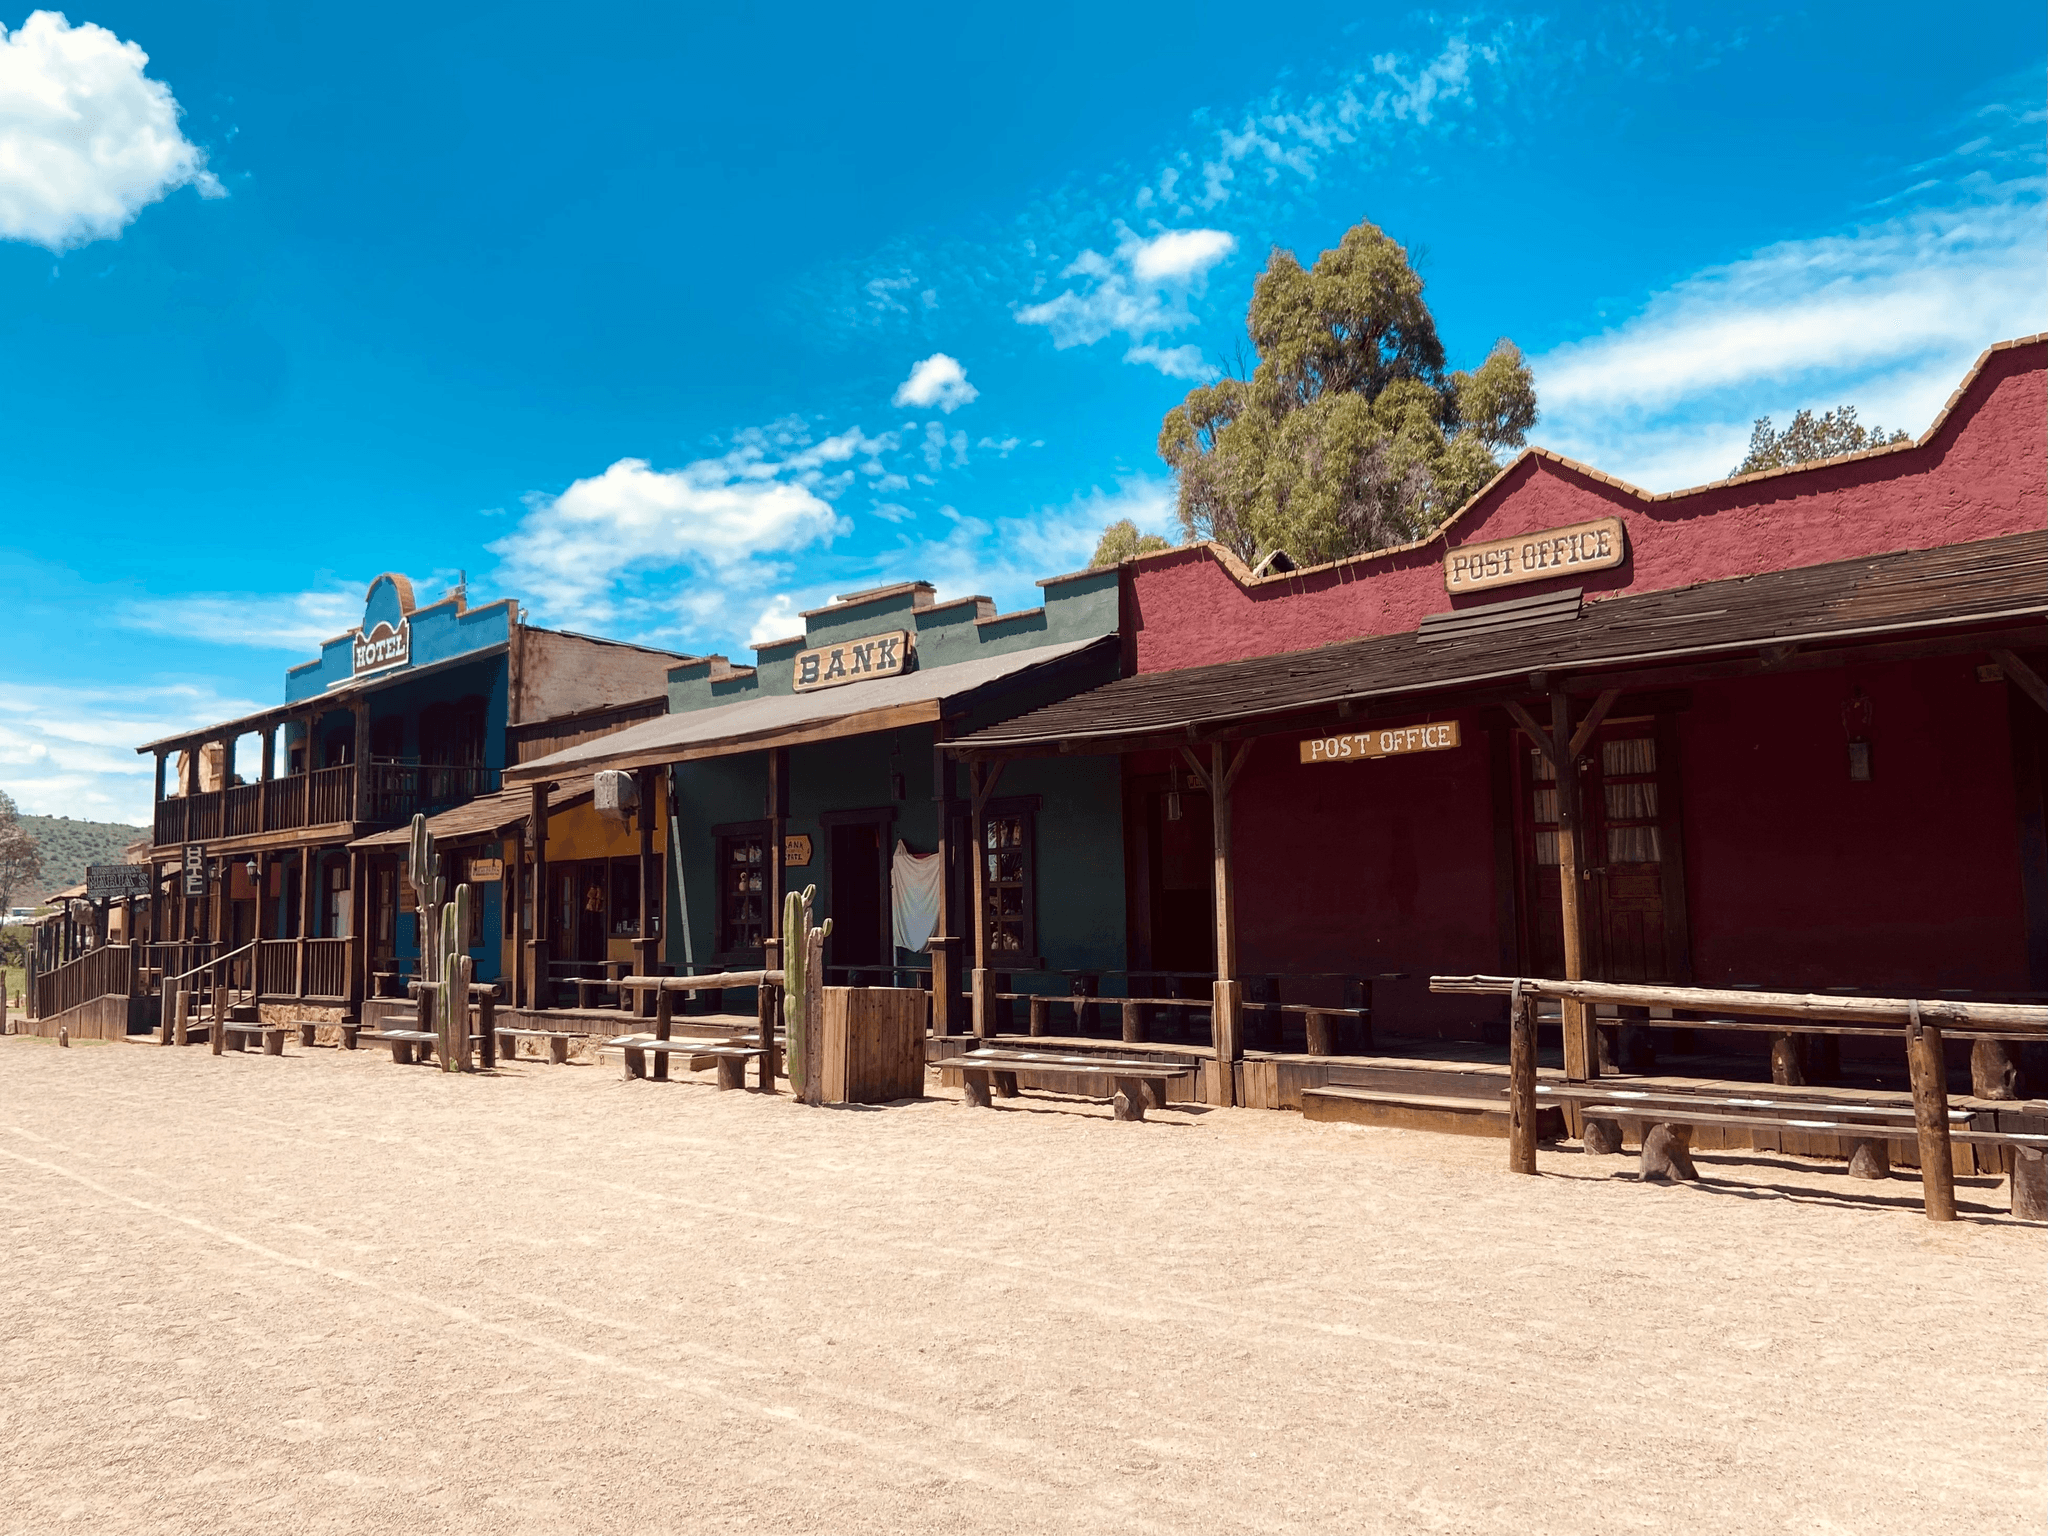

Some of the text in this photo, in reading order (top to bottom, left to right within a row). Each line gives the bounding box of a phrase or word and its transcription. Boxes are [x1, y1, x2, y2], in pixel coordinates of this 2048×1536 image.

[1452, 528, 1612, 583] POST OFFICE
[356, 634, 406, 668] HOTEL
[798, 637, 900, 685] BANK
[1311, 725, 1451, 760] POST OFFICE
[786, 840, 805, 850] ANK
[186, 846, 203, 895] HOTEL
